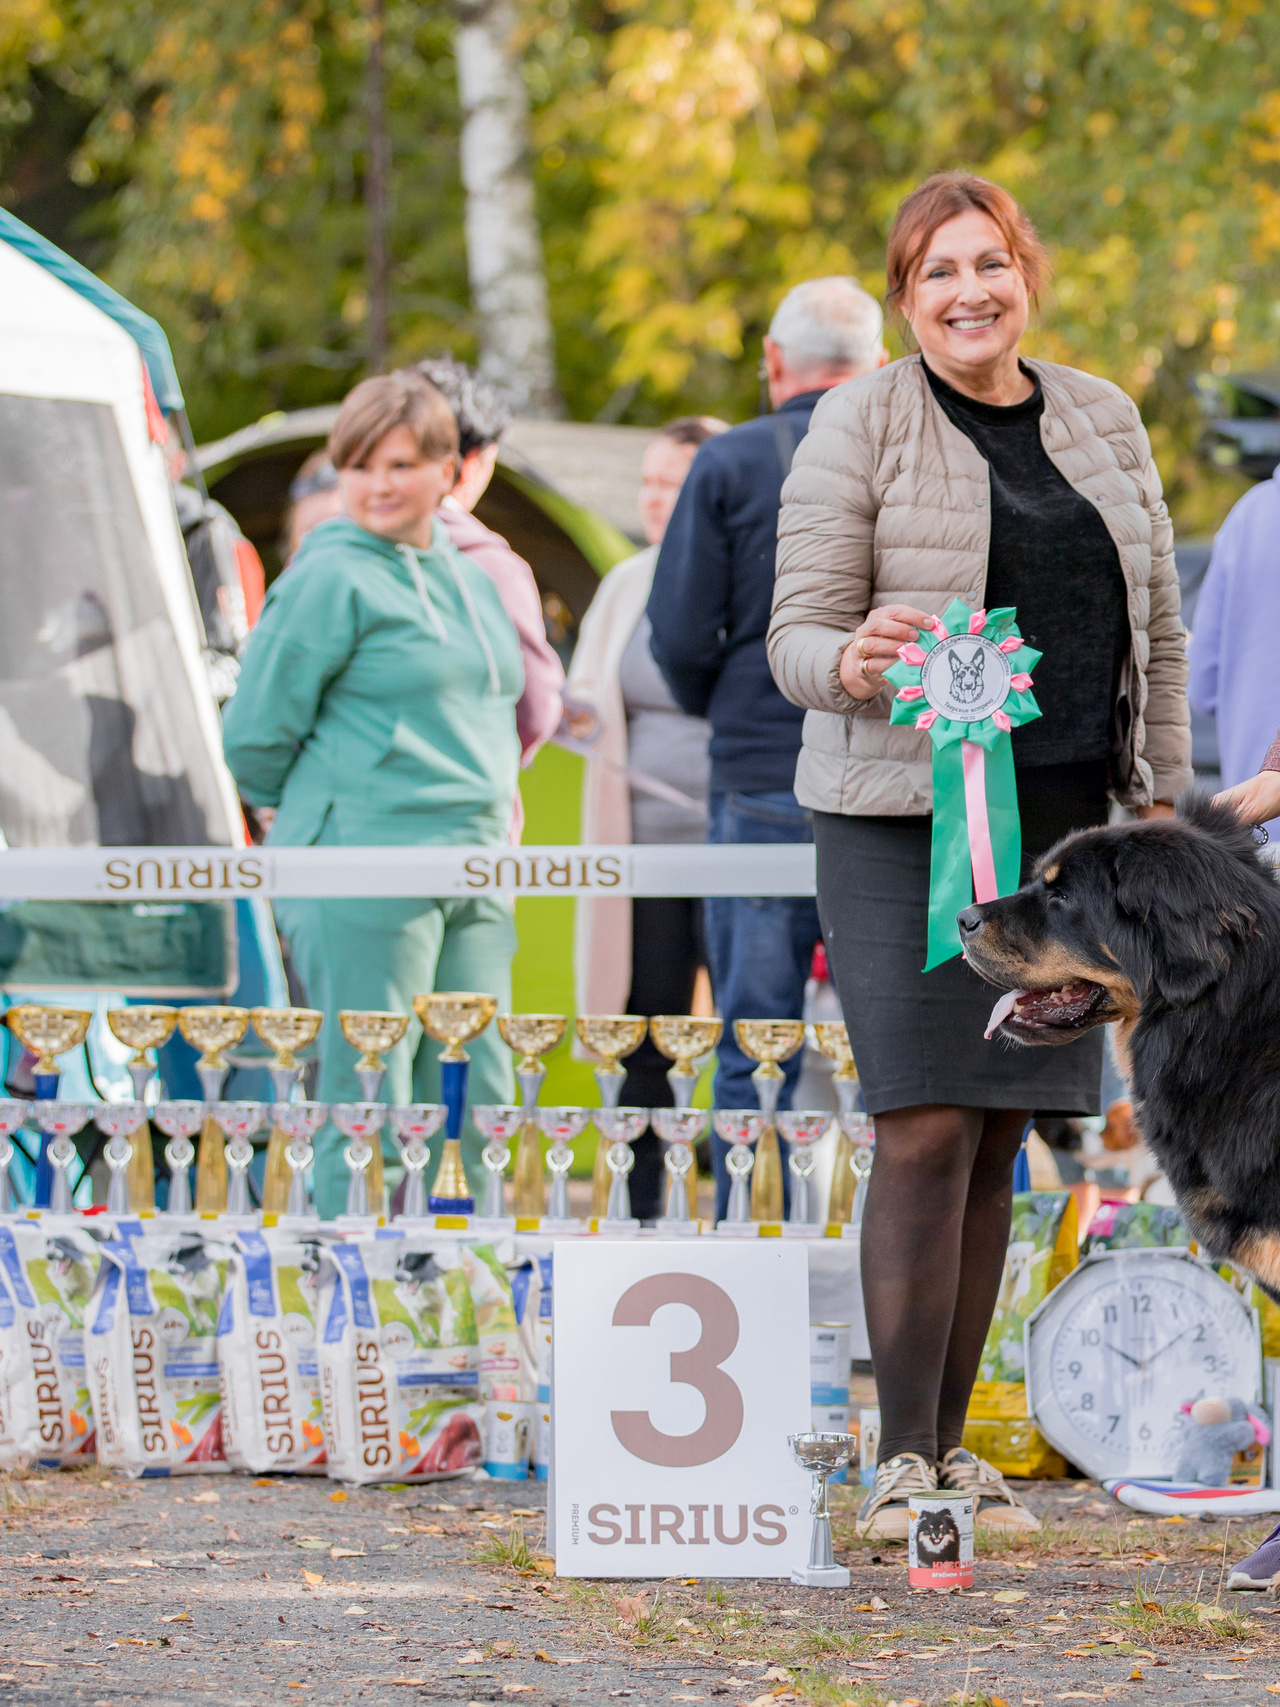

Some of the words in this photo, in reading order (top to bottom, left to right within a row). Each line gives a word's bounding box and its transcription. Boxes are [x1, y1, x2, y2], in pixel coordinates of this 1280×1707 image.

[944, 701, 970, 713] Тверские
[105, 859, 264, 890] SIRIUS
[464, 856, 621, 887] SIRIUS
[1130, 1295, 1152, 1313] 12
[1103, 1305, 1118, 1323] 11
[1079, 1328, 1101, 1346] 10
[1193, 1324, 1206, 1342] 2
[611, 1271, 744, 1468] 3
[1068, 1361, 1082, 1379] 9
[1203, 1355, 1217, 1373] 3
[28, 1320, 65, 1443] SIRIUS
[131, 1327, 168, 1453] SIRIUS
[255, 1329, 295, 1453] SIRIUS
[356, 1340, 392, 1468] SIRIUS
[1081, 1393, 1094, 1411] 8
[1108, 1415, 1121, 1434] 7
[1138, 1422, 1152, 1440] 6
[570, 1502, 580, 1545] PREMIUM
